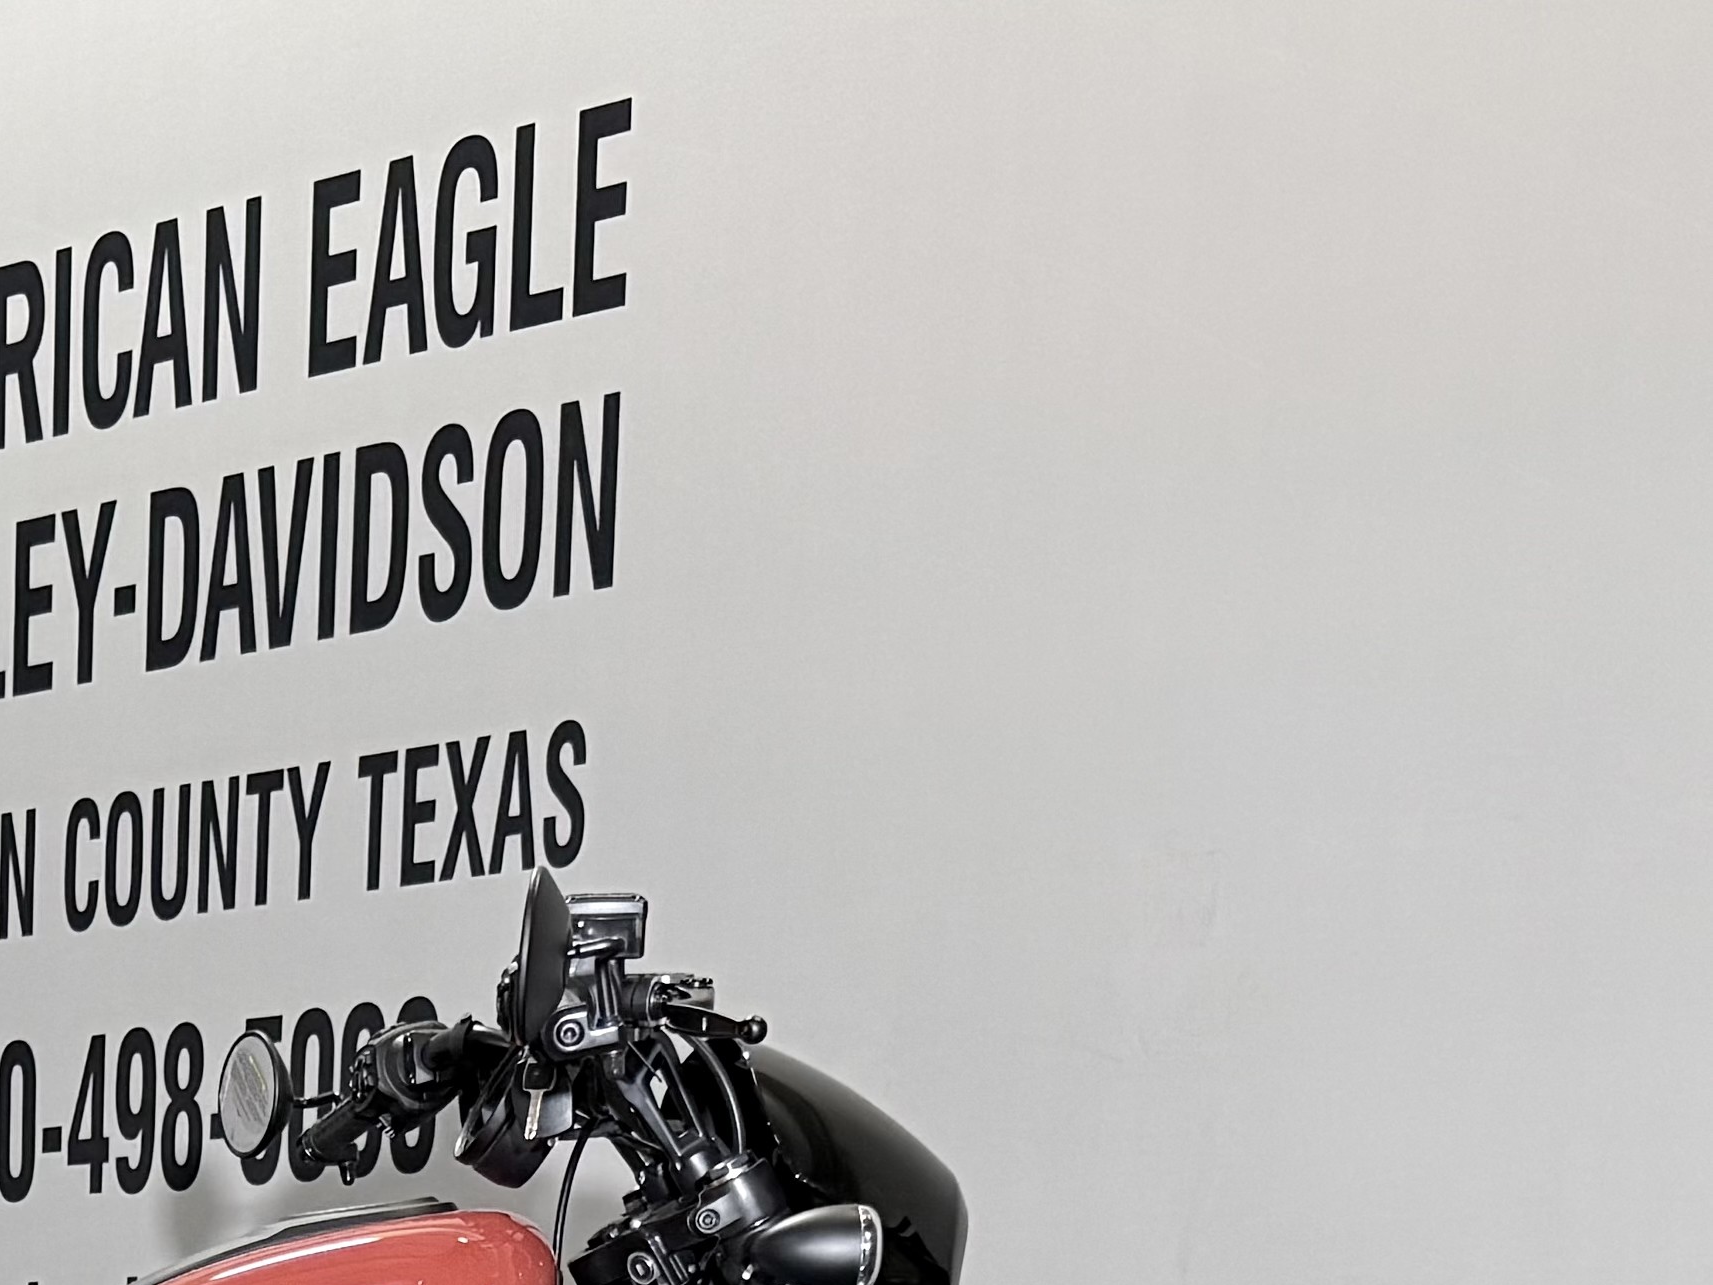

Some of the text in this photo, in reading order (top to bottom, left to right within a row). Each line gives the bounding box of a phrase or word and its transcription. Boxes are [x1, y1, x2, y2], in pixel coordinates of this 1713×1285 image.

[307, 97, 634, 379] EAGLE
[64, 760, 333, 933] COUNTY
[357, 719, 588, 892] TEXAS
